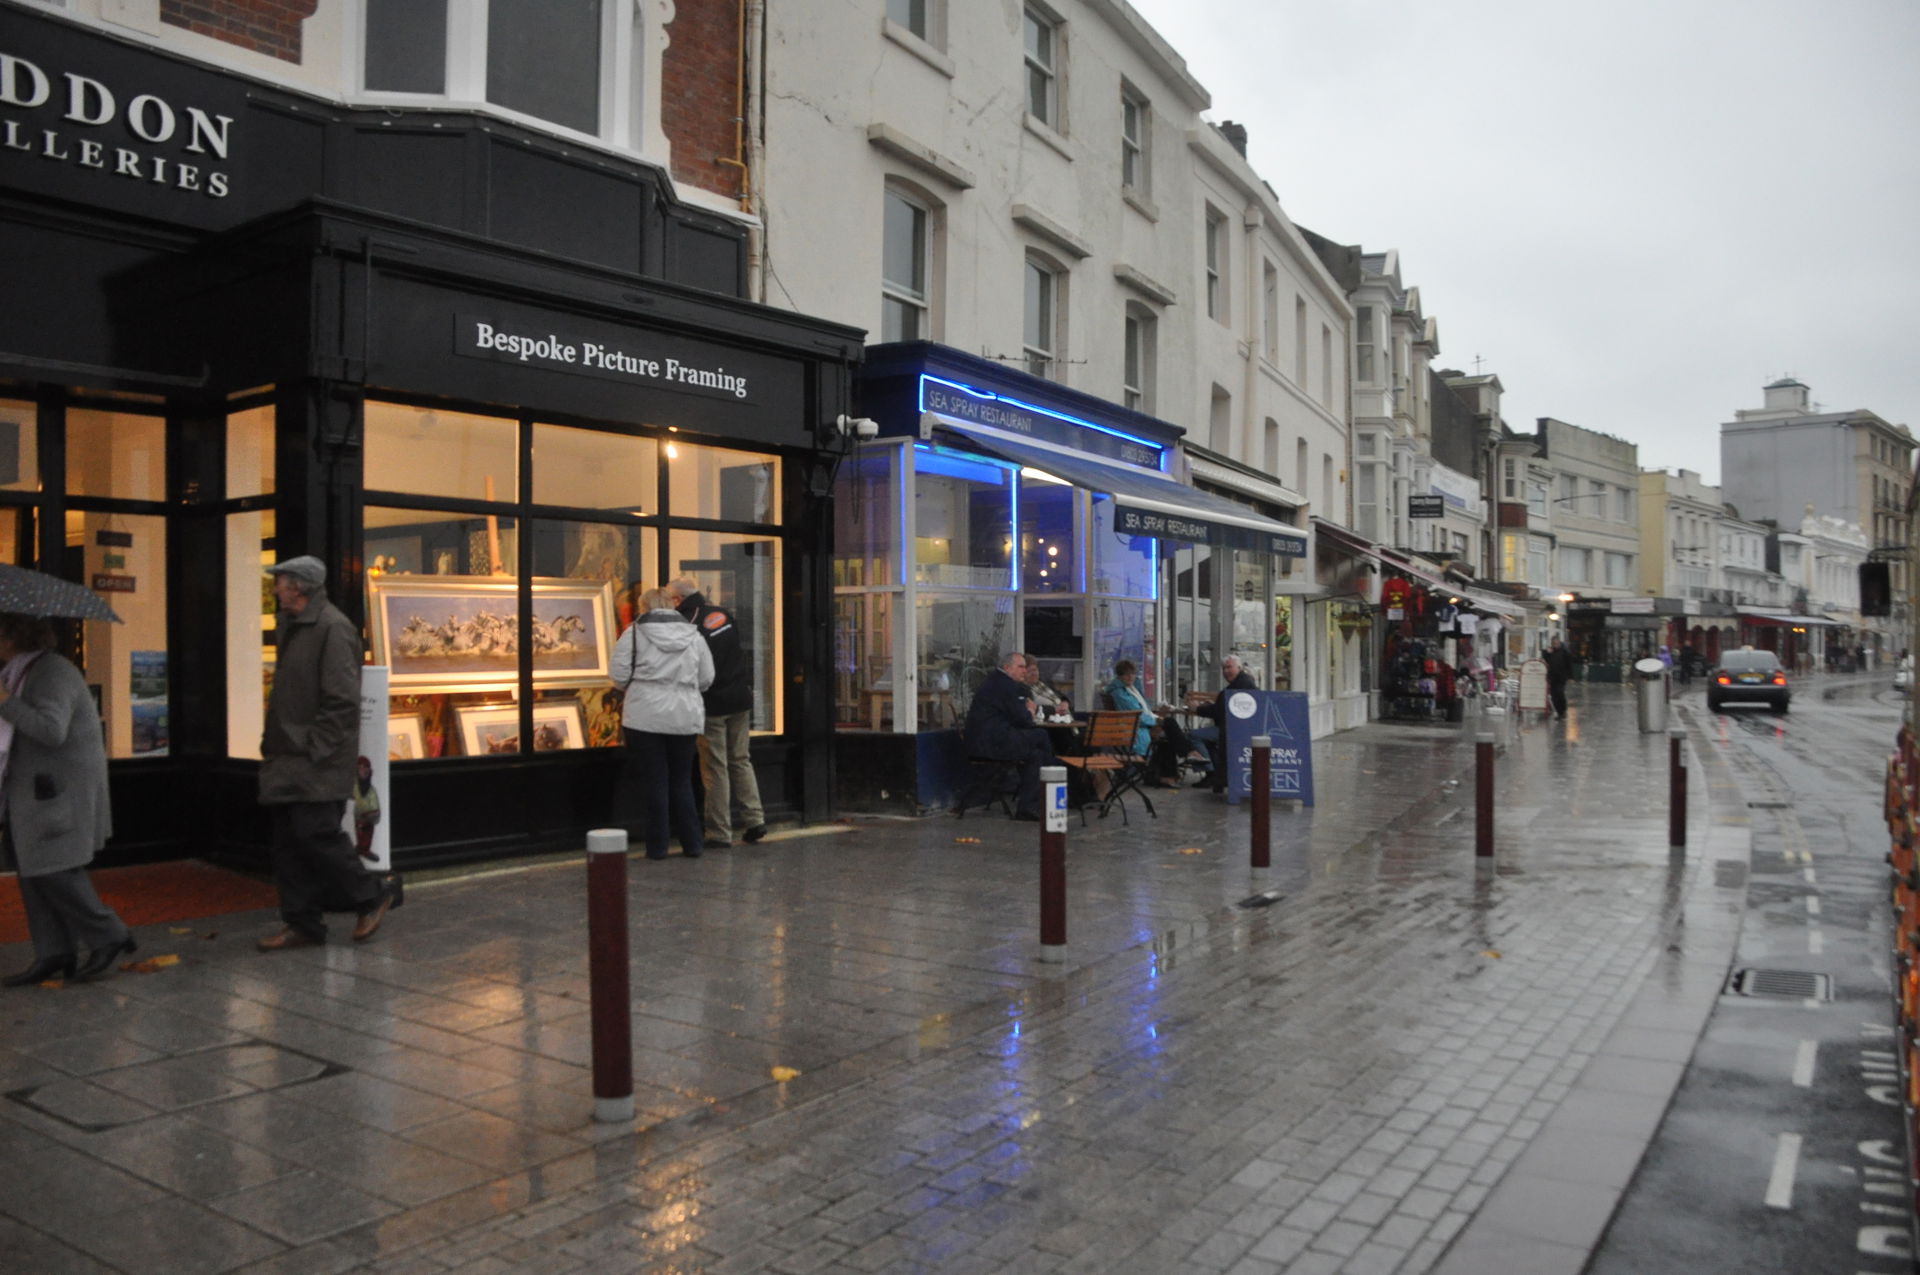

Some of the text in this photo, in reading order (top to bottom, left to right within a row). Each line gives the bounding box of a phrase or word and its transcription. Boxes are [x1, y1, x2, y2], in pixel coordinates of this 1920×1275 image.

[476, 322, 747, 398] Bespoke Picture Framing
[929, 390, 1032, 432] SEA SPRAY RESTAURANT
[1125, 513, 1208, 538] SEA SPRAY RESTAURANT
[1271, 748, 1297, 758] PRAY
[1242, 771, 1300, 789] OEN
